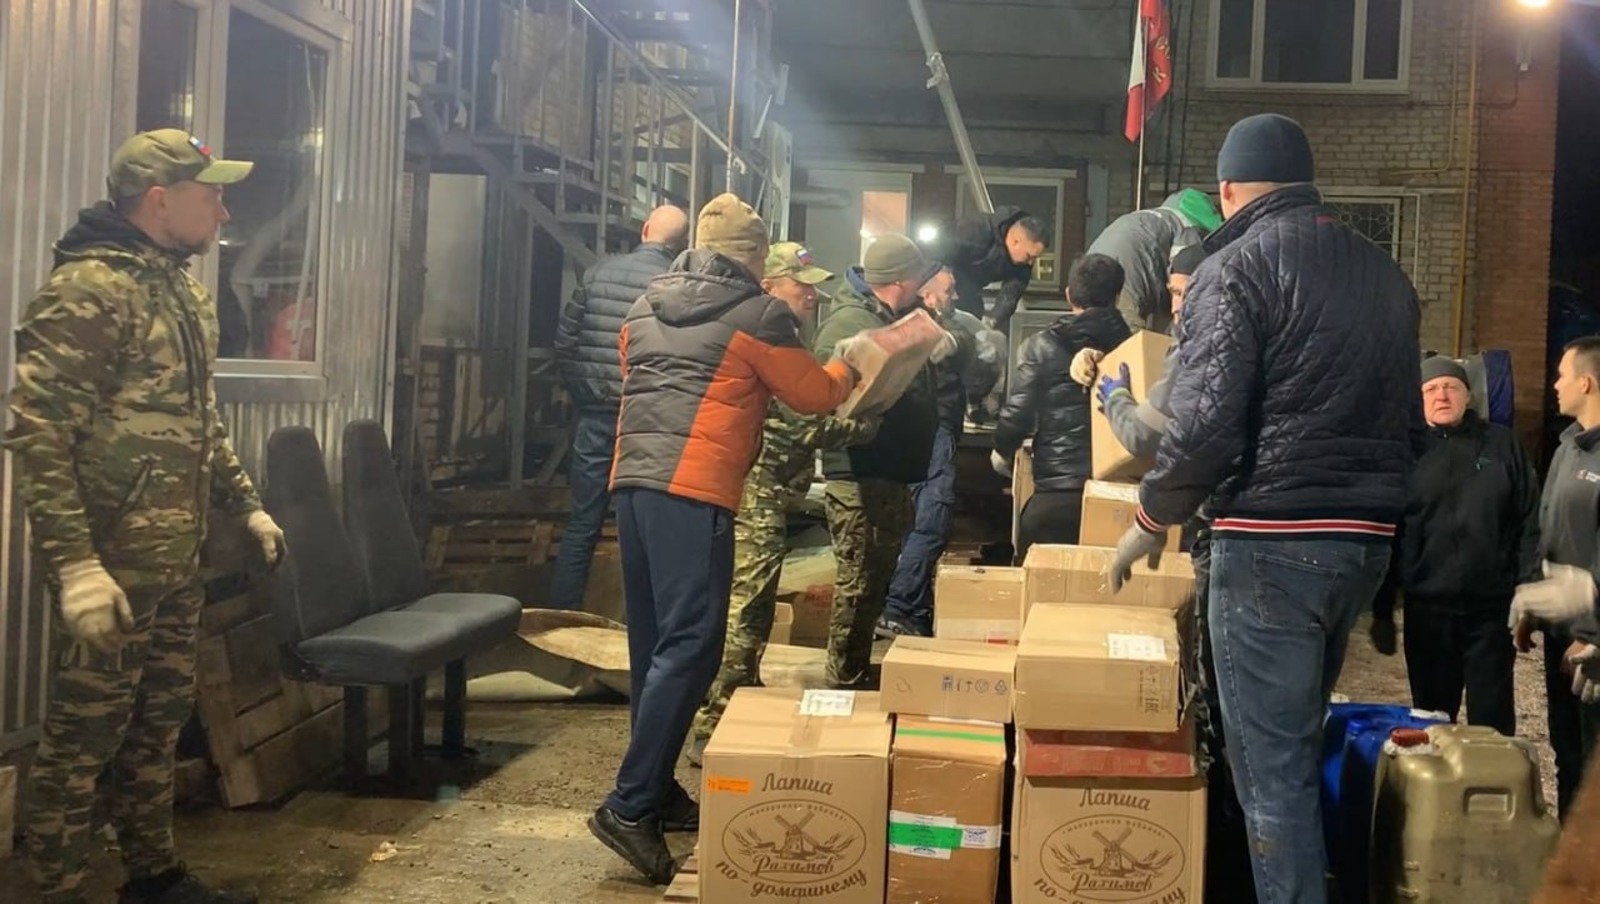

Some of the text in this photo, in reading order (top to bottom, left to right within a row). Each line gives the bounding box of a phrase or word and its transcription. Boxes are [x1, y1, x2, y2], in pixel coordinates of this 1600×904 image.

[762, 772, 834, 796] Лапша
[1080, 787, 1151, 811] Лапша
[751, 854, 834, 877] Рахимов
[1071, 871, 1153, 895] Рахимов
